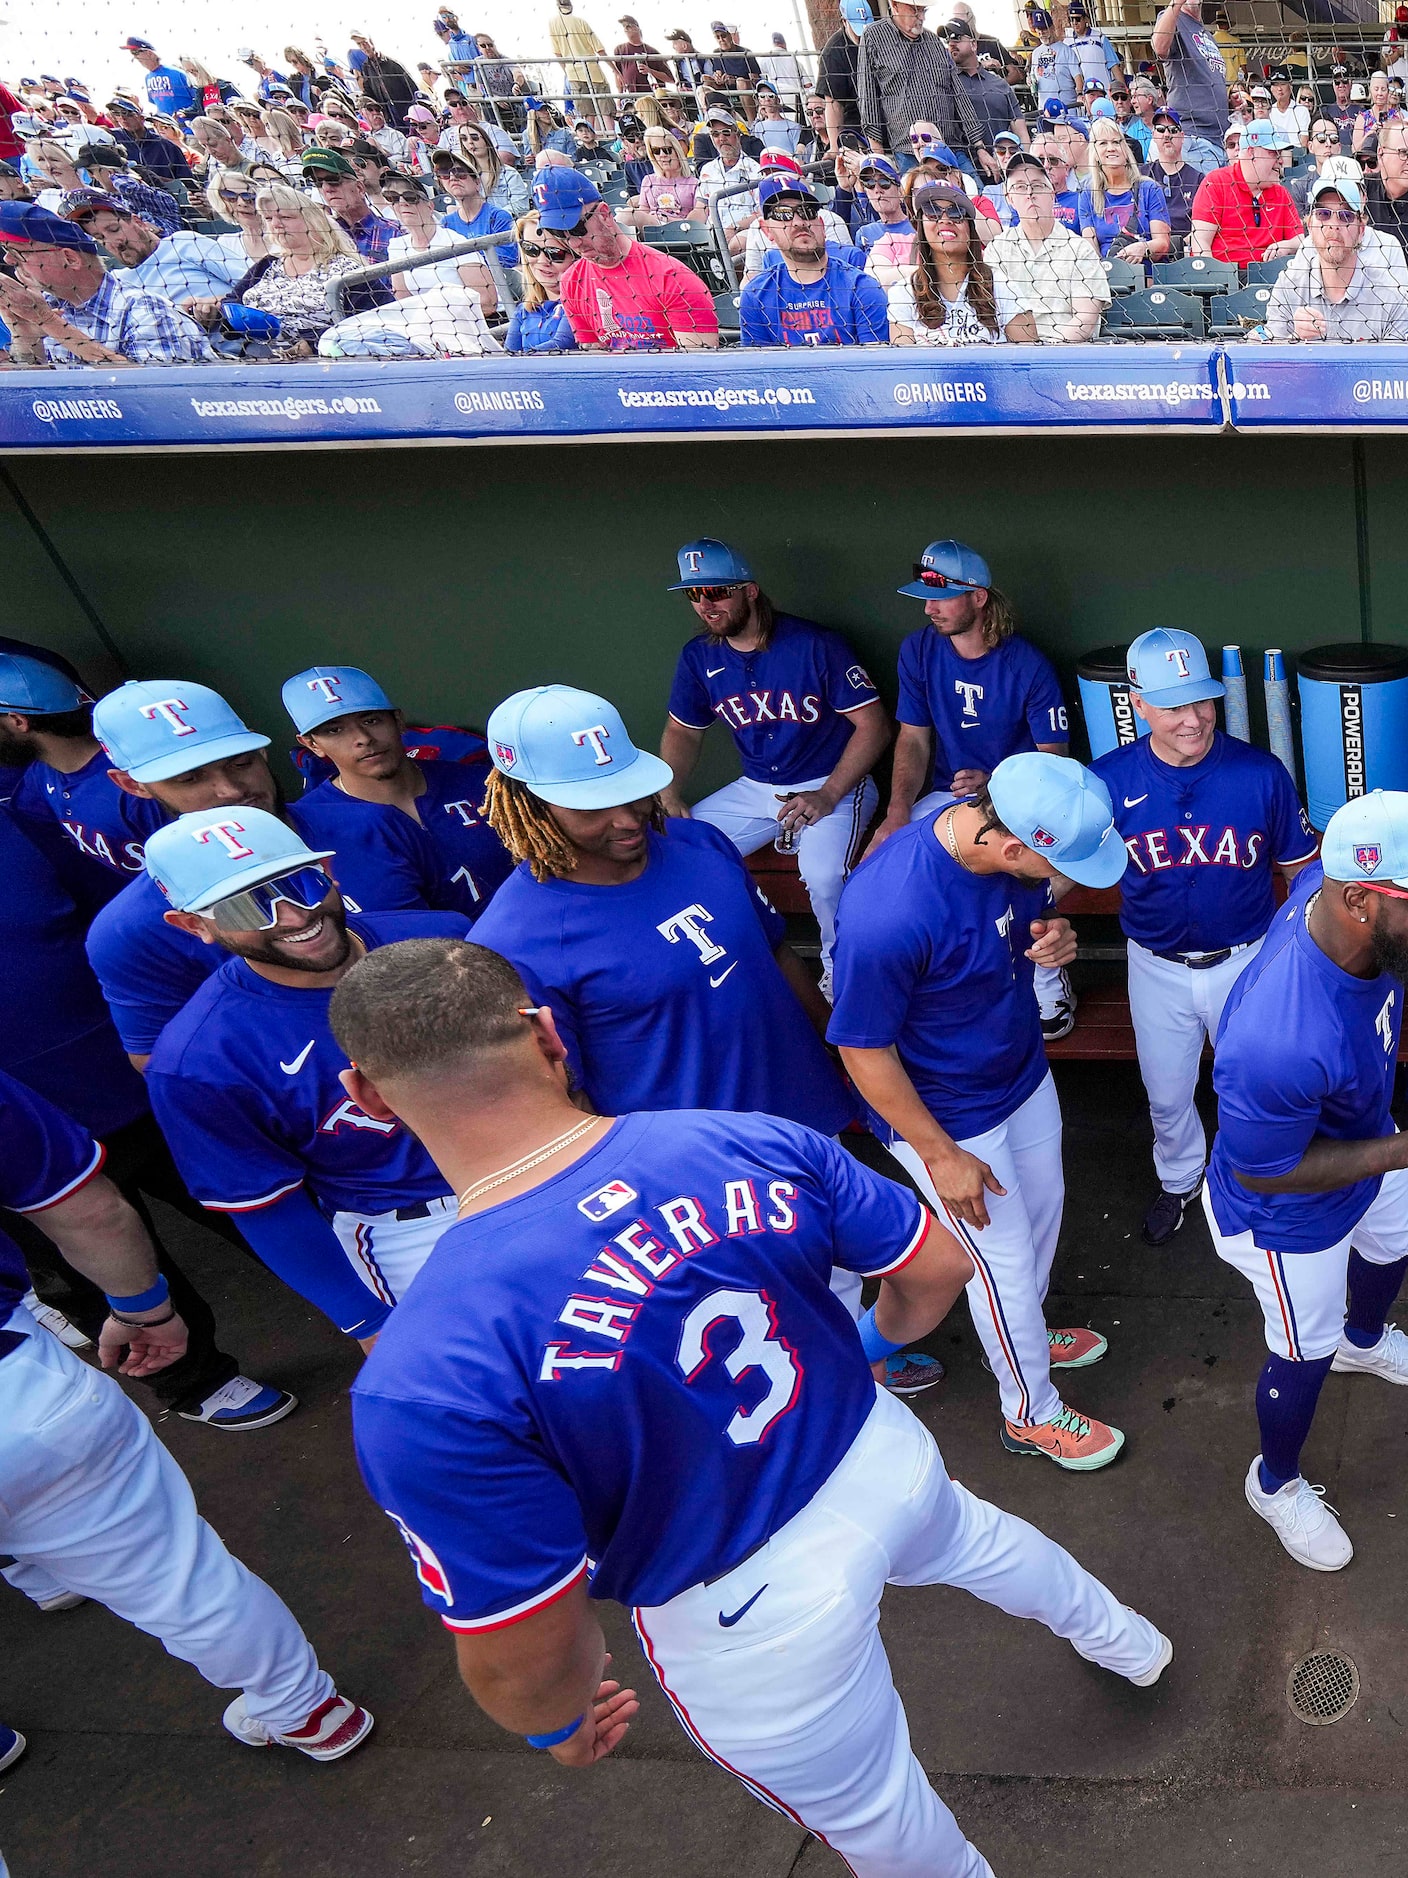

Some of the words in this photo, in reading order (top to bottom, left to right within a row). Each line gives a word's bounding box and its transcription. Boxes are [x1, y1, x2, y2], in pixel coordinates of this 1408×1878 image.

[856, 8, 866, 19] T
[1035, 13, 1043, 22] T
[770, 153, 778, 163] T
[929, 142, 938, 151] T
[869, 158, 878, 166] T
[1335, 160, 1348, 175] NY
[533, 184, 548, 205] T
[774, 175, 791, 190] T
[787, 300, 826, 310] SURPRISE
[454, 389, 545, 414] @RANGERS
[617, 387, 815, 411] texasrangers.com
[893, 382, 987, 405] @RANGERS
[1066, 380, 1271, 405] texasrangers.com
[33, 400, 122, 422] @RANGERS
[191, 396, 381, 420] texasrangers.com
[684, 551, 705, 573] T
[1165, 649, 1190, 678] T
[306, 676, 343, 703] T
[954, 679, 983, 718] T
[138, 698, 197, 737] T
[714, 691, 822, 730] TEXAS
[1048, 706, 1069, 731] 16
[1113, 692, 1137, 747] POWE
[571, 724, 612, 766] T
[1343, 692, 1365, 797] POWERADE
[444, 799, 482, 829] T
[62, 821, 147, 874] XAS
[192, 819, 255, 861] T
[1124, 824, 1264, 876] TEXAS
[1357, 848, 1379, 861] 24
[450, 865, 482, 903] 7
[656, 902, 728, 966] T
[537, 1178, 798, 1383] TAVERAS
[673, 1285, 804, 1448] 3
